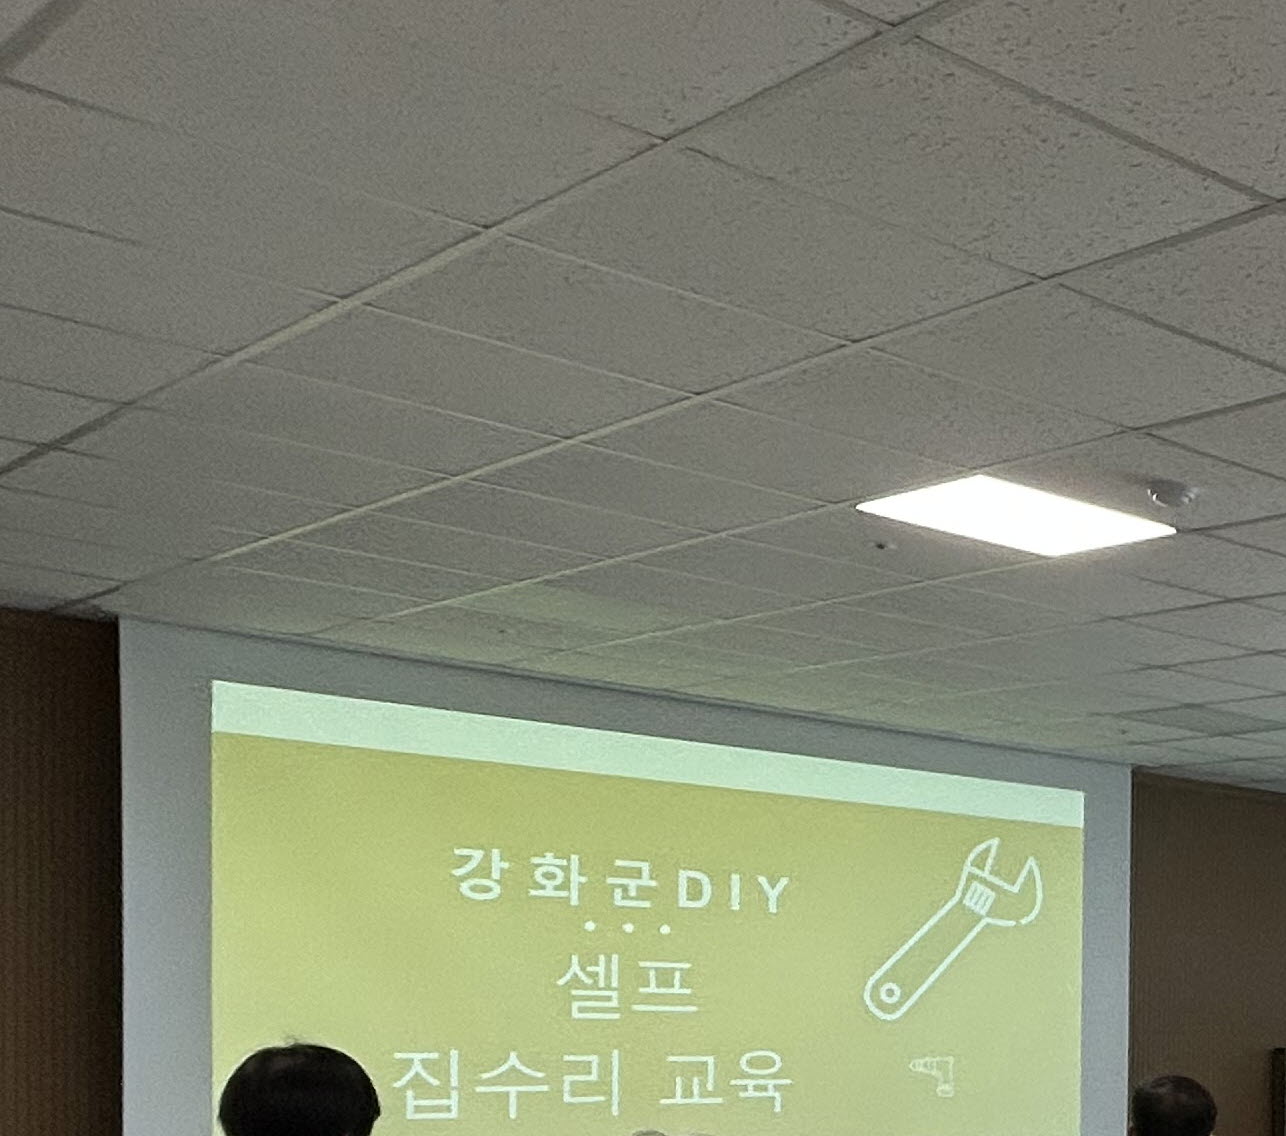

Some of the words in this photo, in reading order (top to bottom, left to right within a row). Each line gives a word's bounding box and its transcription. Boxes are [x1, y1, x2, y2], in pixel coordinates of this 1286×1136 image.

[556, 953, 699, 1020] 셀프
[392, 1048, 620, 1120] 집수리
[659, 1050, 793, 1113] 교육
